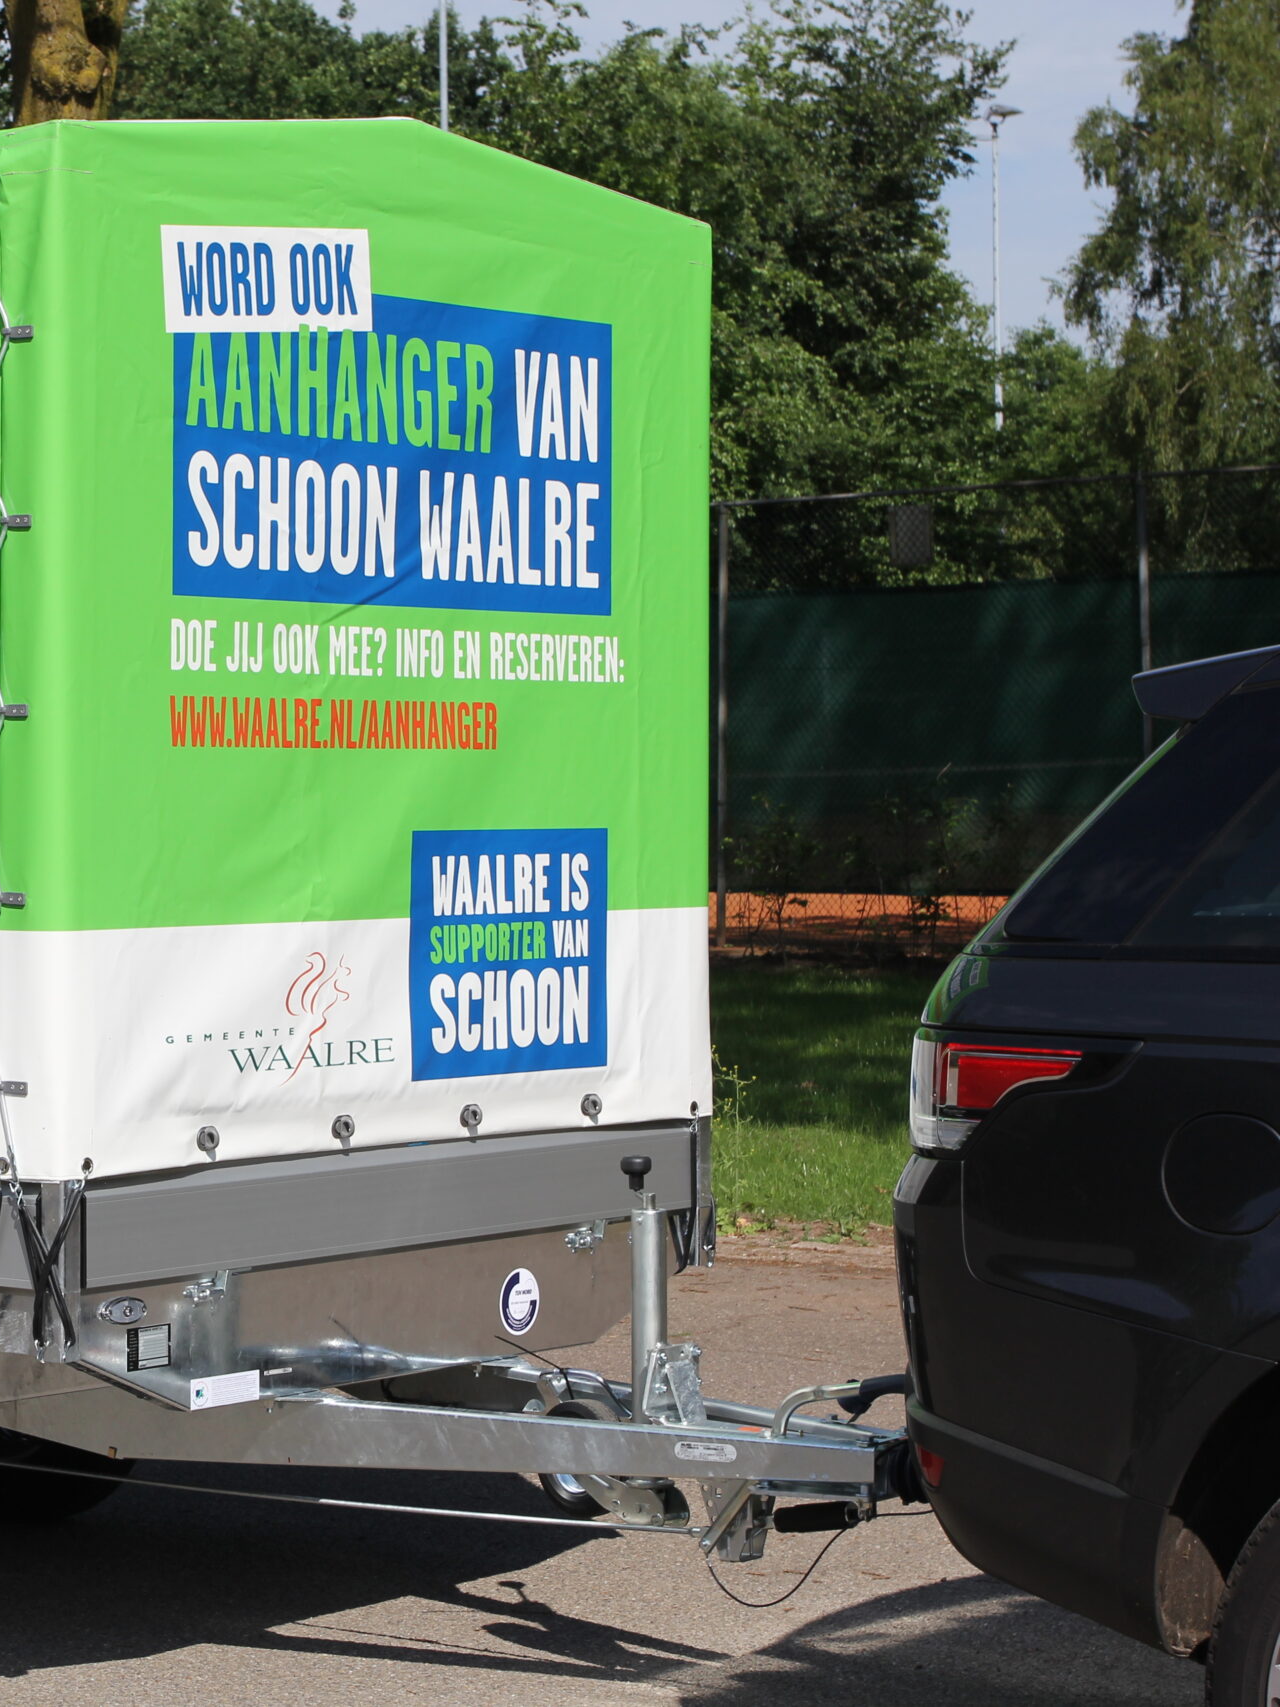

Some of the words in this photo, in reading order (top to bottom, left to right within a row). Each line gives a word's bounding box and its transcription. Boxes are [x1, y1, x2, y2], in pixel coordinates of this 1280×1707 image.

[177, 241, 275, 317] WORD
[290, 242, 358, 316] OOK
[186, 323, 494, 454] AANHANGER
[514, 348, 598, 463] VAN
[187, 450, 398, 578] SCHOON
[419, 469, 600, 588] WAALRE
[170, 618, 217, 672] DOE
[225, 621, 263, 673] JIJ
[273, 623, 320, 675] OOK
[329, 625, 387, 677] MEE?
[396, 628, 444, 679] INFO
[453, 630, 480, 679] EN
[489, 632, 625, 684] RESERVEREN:
[169, 695, 498, 750] WWW.WAALRE.NL/AANHANGER
[431, 853, 550, 917] WAALRE
[560, 852, 589, 912] IS
[429, 920, 546, 965] SUPPORTER
[552, 919, 589, 959] VAN
[165, 1027, 295, 1045] GEMEENTE
[429, 965, 589, 1054] SCHOON
[227, 1037, 395, 1074] WAALRE
